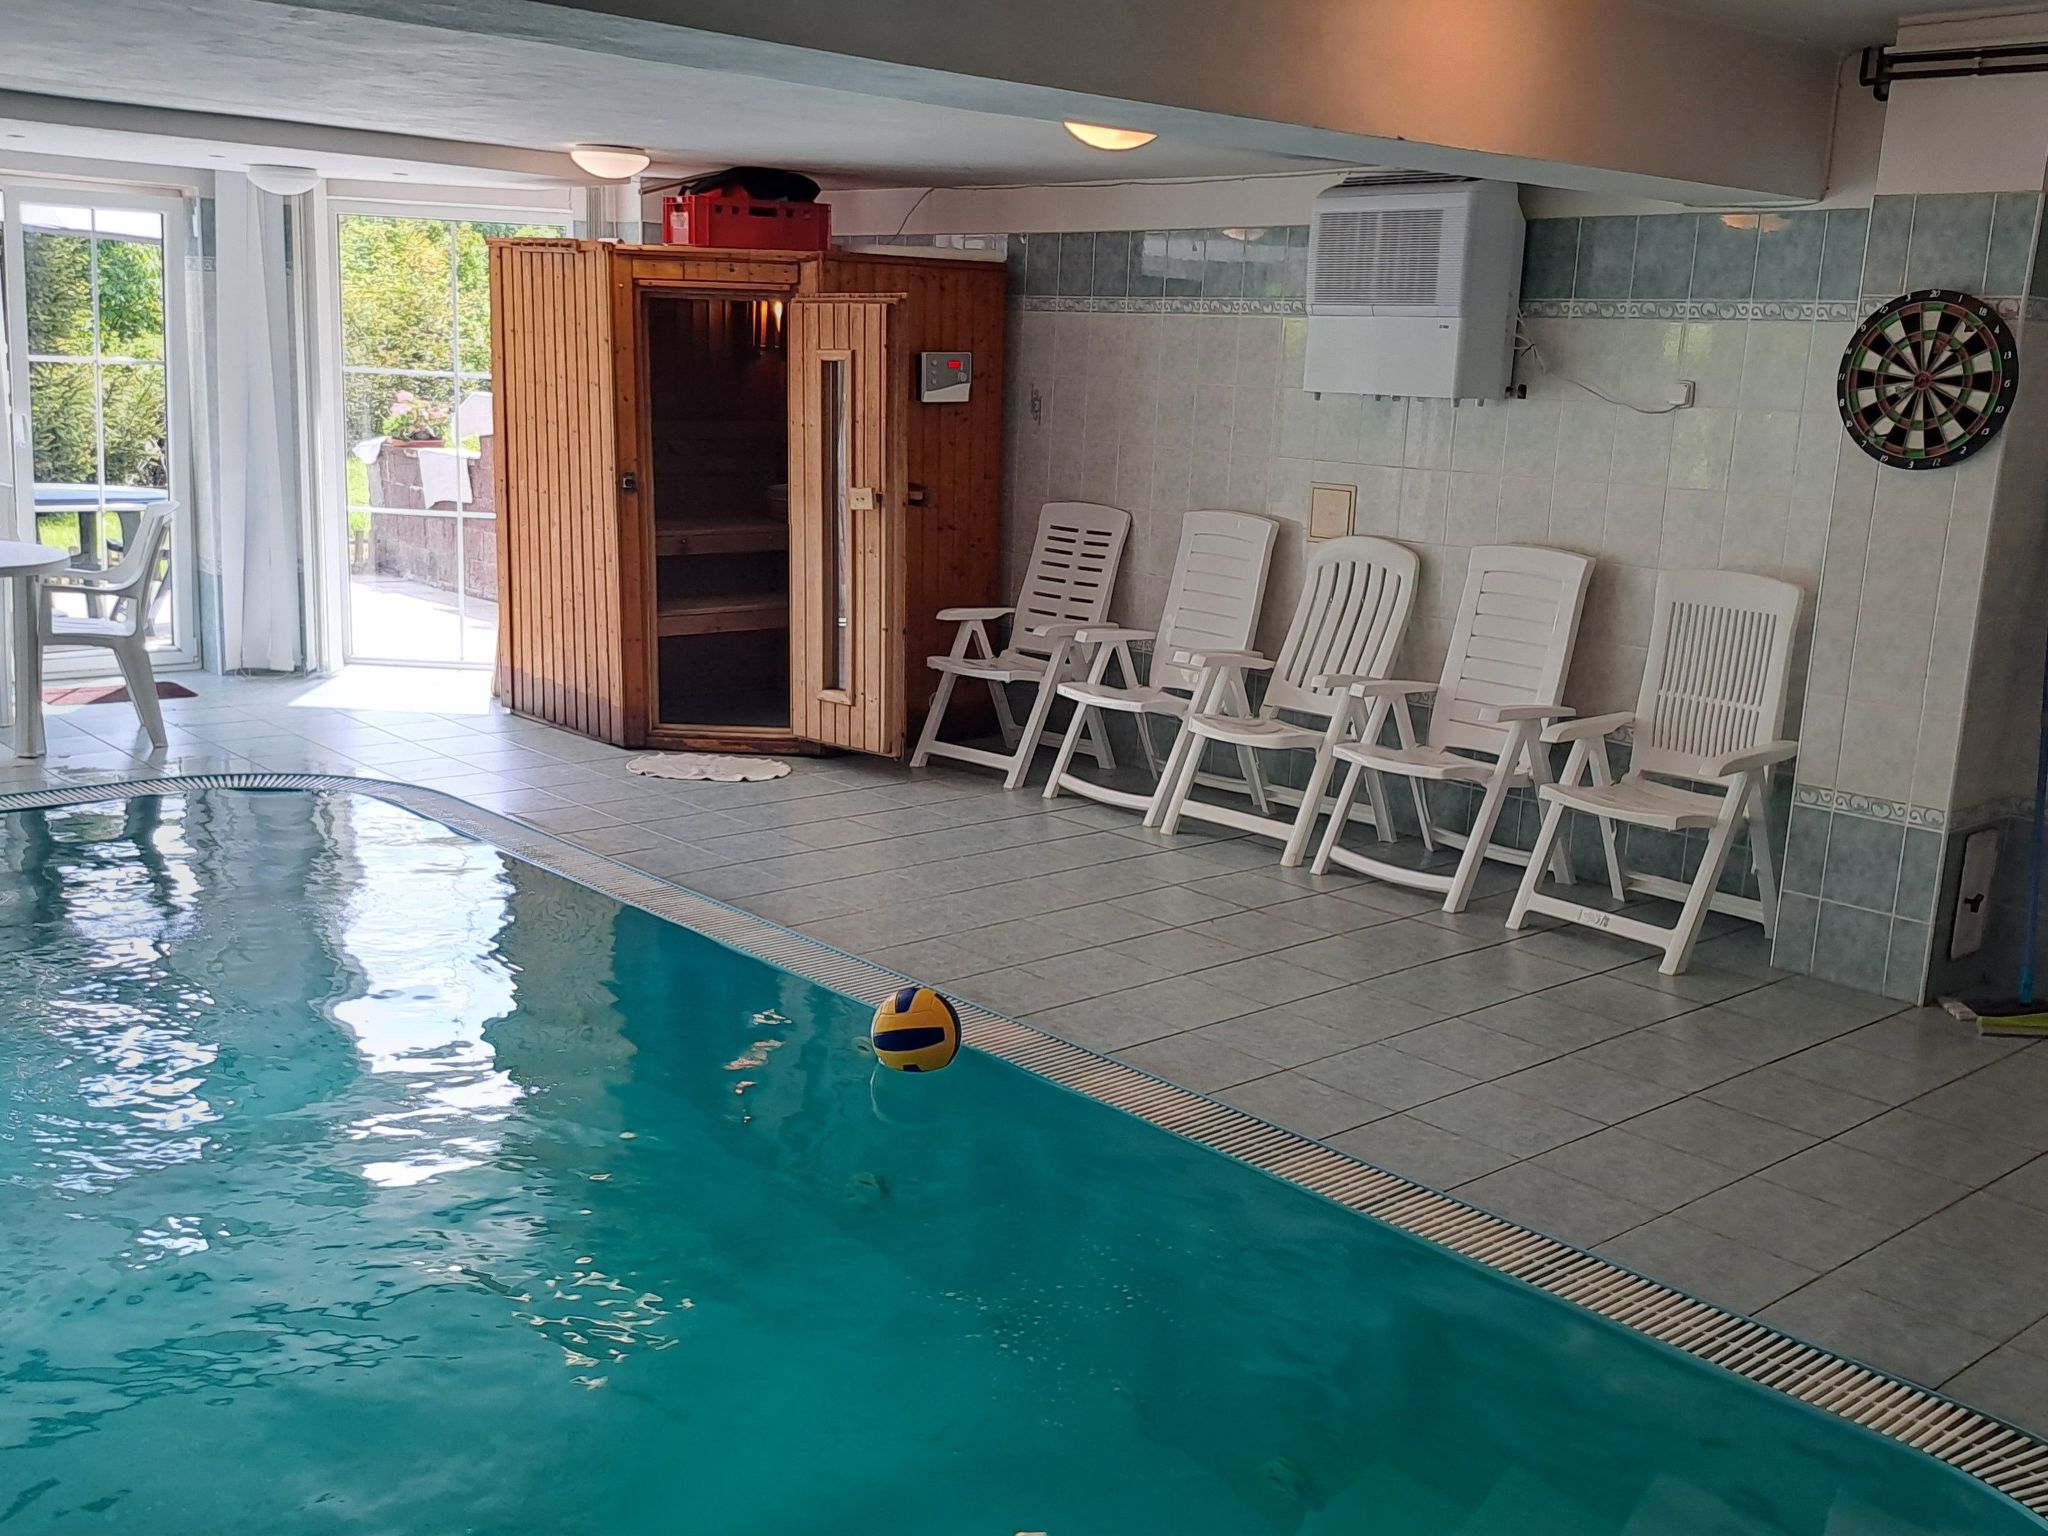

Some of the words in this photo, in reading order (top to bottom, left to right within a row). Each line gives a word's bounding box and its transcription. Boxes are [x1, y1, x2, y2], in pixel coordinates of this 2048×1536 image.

[1928, 290, 1940, 298] 20
[1860, 324, 1866, 332] 9
[1838, 372, 1846, 381] 11
[2004, 379, 2011, 388] 6
[1839, 398, 1845, 407] 8
[1861, 440, 1867, 448] 7
[1960, 446, 1967, 454] 2
[1907, 460, 1914, 468] 3
